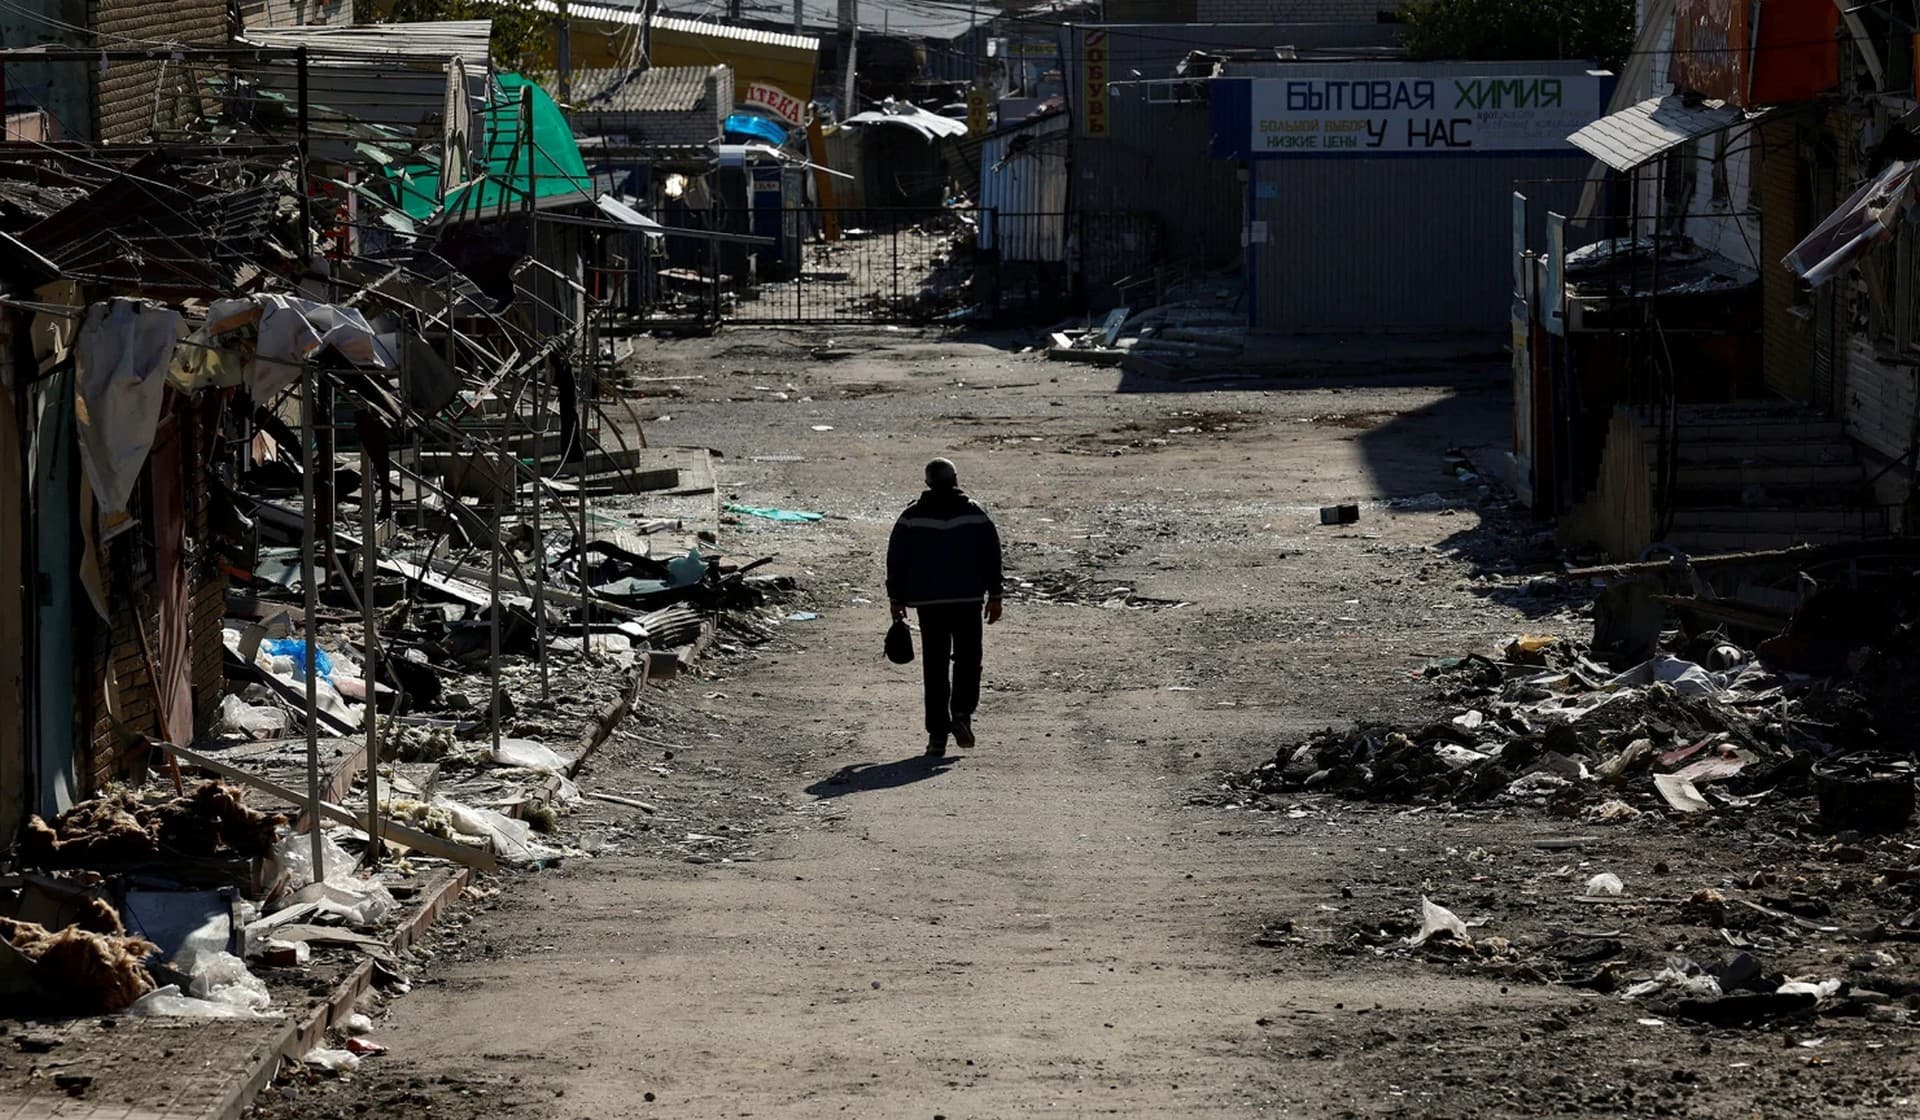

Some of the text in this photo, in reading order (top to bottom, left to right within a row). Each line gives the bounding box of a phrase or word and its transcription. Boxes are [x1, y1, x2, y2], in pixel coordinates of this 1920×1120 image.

[1088, 49, 1104, 133] ОБУВЬ
[1287, 79, 1562, 111] БЫТОВАЯ ХИМИЯ
[1260, 119, 1367, 132] БОЛЬШОЙ ВЫБОР
[1366, 118, 1472, 147] У НАС
[1266, 135, 1357, 149] НИЗКИЕ ЦЕНЫ
